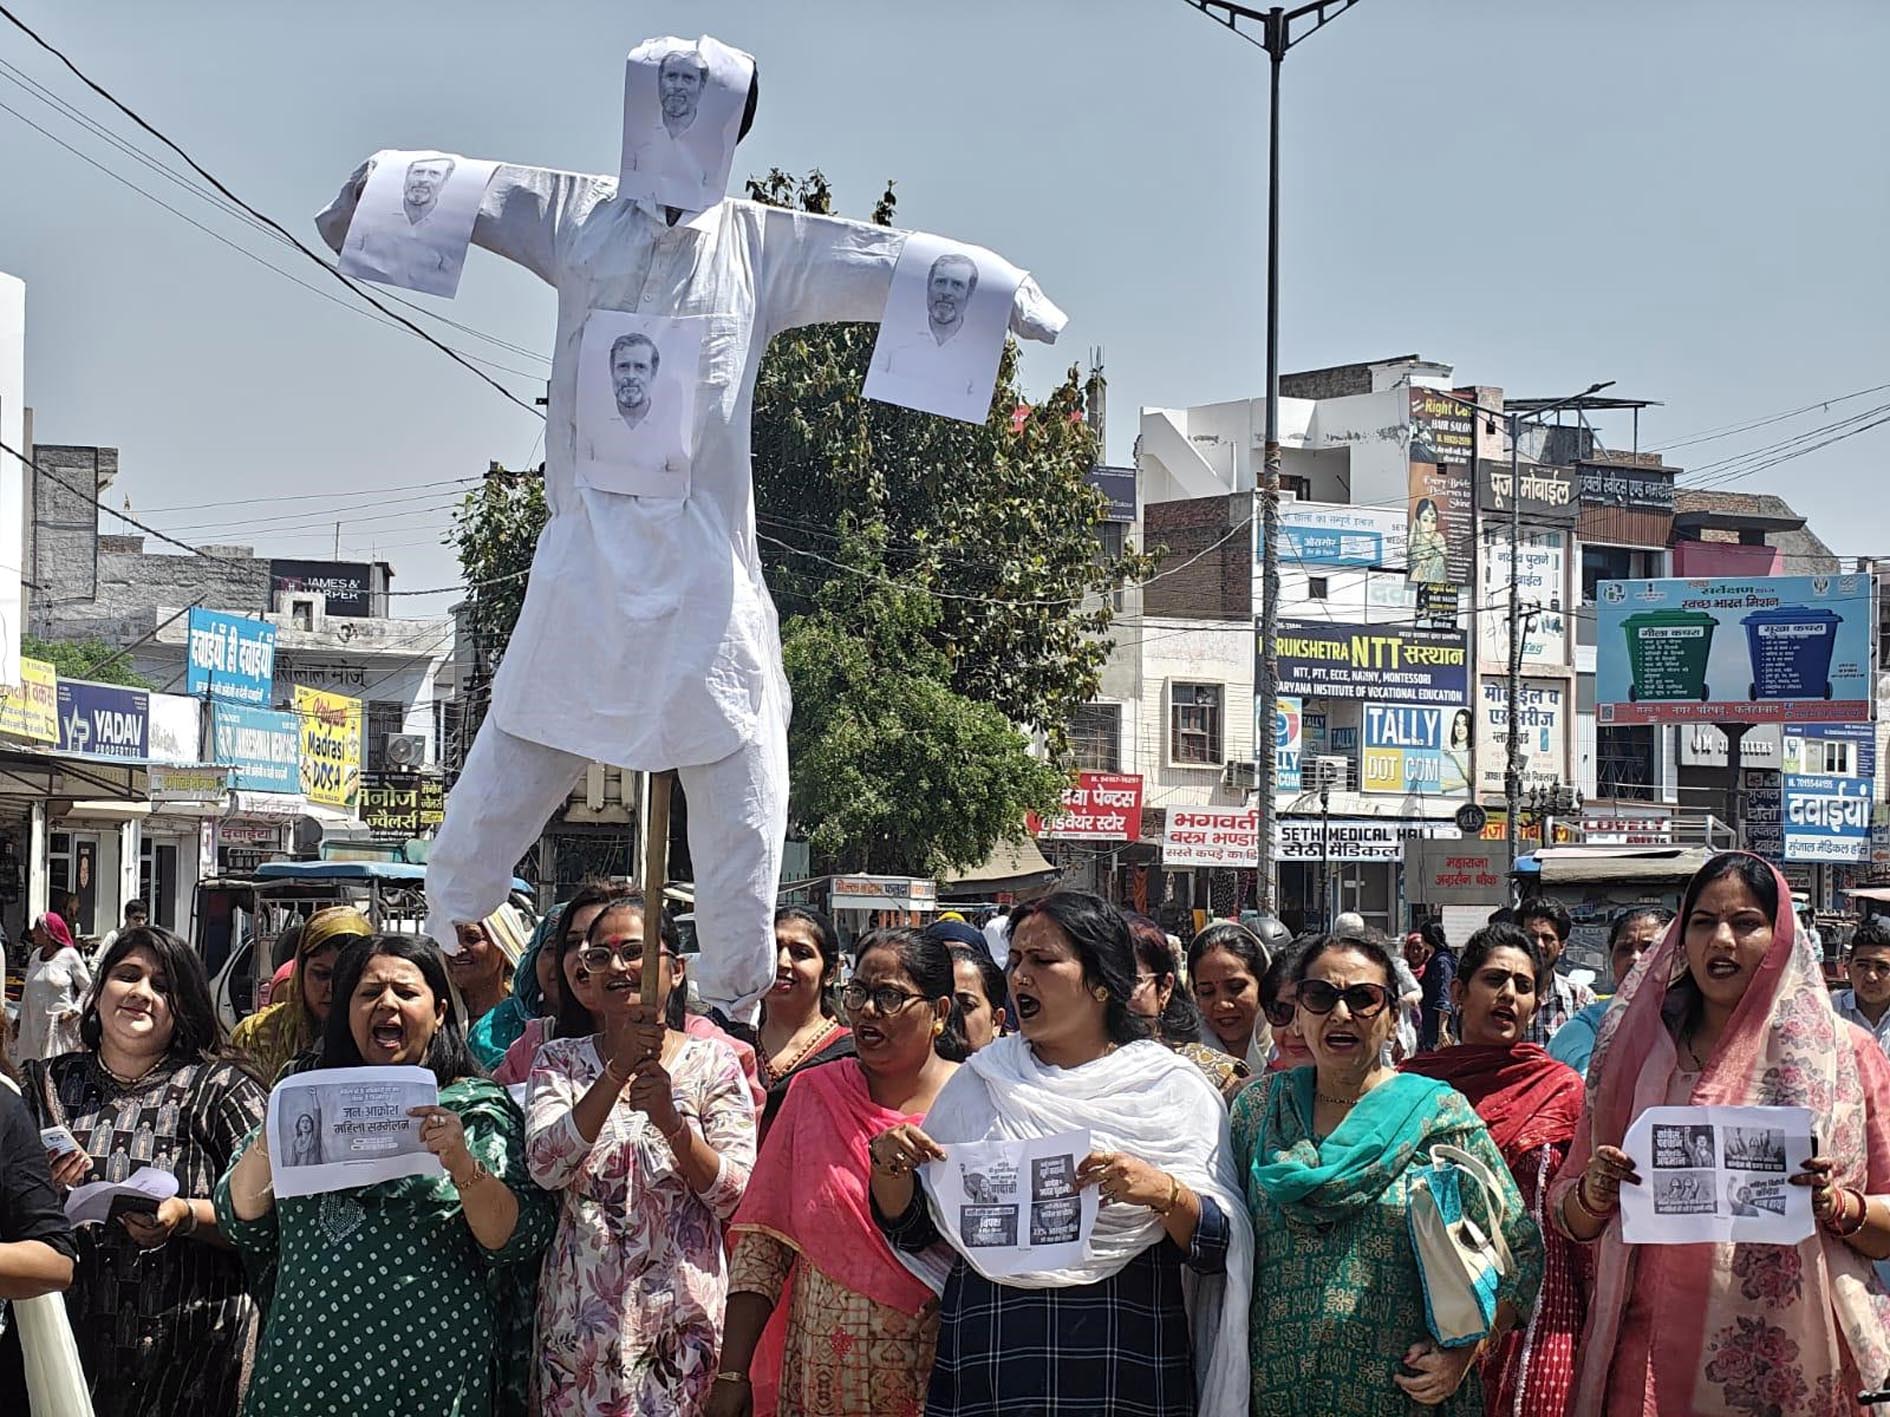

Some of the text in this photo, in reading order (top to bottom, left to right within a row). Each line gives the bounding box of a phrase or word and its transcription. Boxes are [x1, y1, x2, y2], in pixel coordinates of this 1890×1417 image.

[1425, 398, 1452, 417] Right
[1431, 419, 1472, 433] HAIR SALON
[1519, 469, 1571, 507] मोबाईल
[308, 577, 347, 589] JAMES
[1714, 599, 1742, 609] भारत
[1743, 594, 1779, 608] मिशन
[1352, 636, 1404, 669] NTT
[1403, 640, 1465, 666] संस्थान
[1312, 668, 1329, 681] PTT,
[1330, 669, 1350, 682] ECCE,
[1383, 673, 1431, 685] MONTESSORI
[1277, 681, 1463, 702] ARYANA INSTITUTE OF VOCATIONAL EDUCATION
[94, 709, 143, 747] YADAV
[1368, 708, 1438, 747] TALLY
[308, 731, 346, 761] Madrasi
[313, 760, 341, 791] DOSA
[1368, 756, 1439, 783] DOT COM
[359, 782, 418, 808] मनोज
[1787, 781, 1871, 833] दवाईयां
[1096, 811, 1126, 831] स्टोर
[1170, 830, 1258, 847] वस्त्र भण्डा
[1281, 827, 1326, 842] SETHI
[1328, 827, 1392, 842] MEDICAL
[1165, 847, 1192, 857] सस्ते
[1227, 849, 1243, 858] का
[1247, 848, 1258, 860] डि
[1328, 841, 1400, 858] मैडिकल
[1446, 856, 1488, 869] महाराजा
[1475, 872, 1498, 886] चौक
[333, 1118, 409, 1134] महिला सम्मेलन
